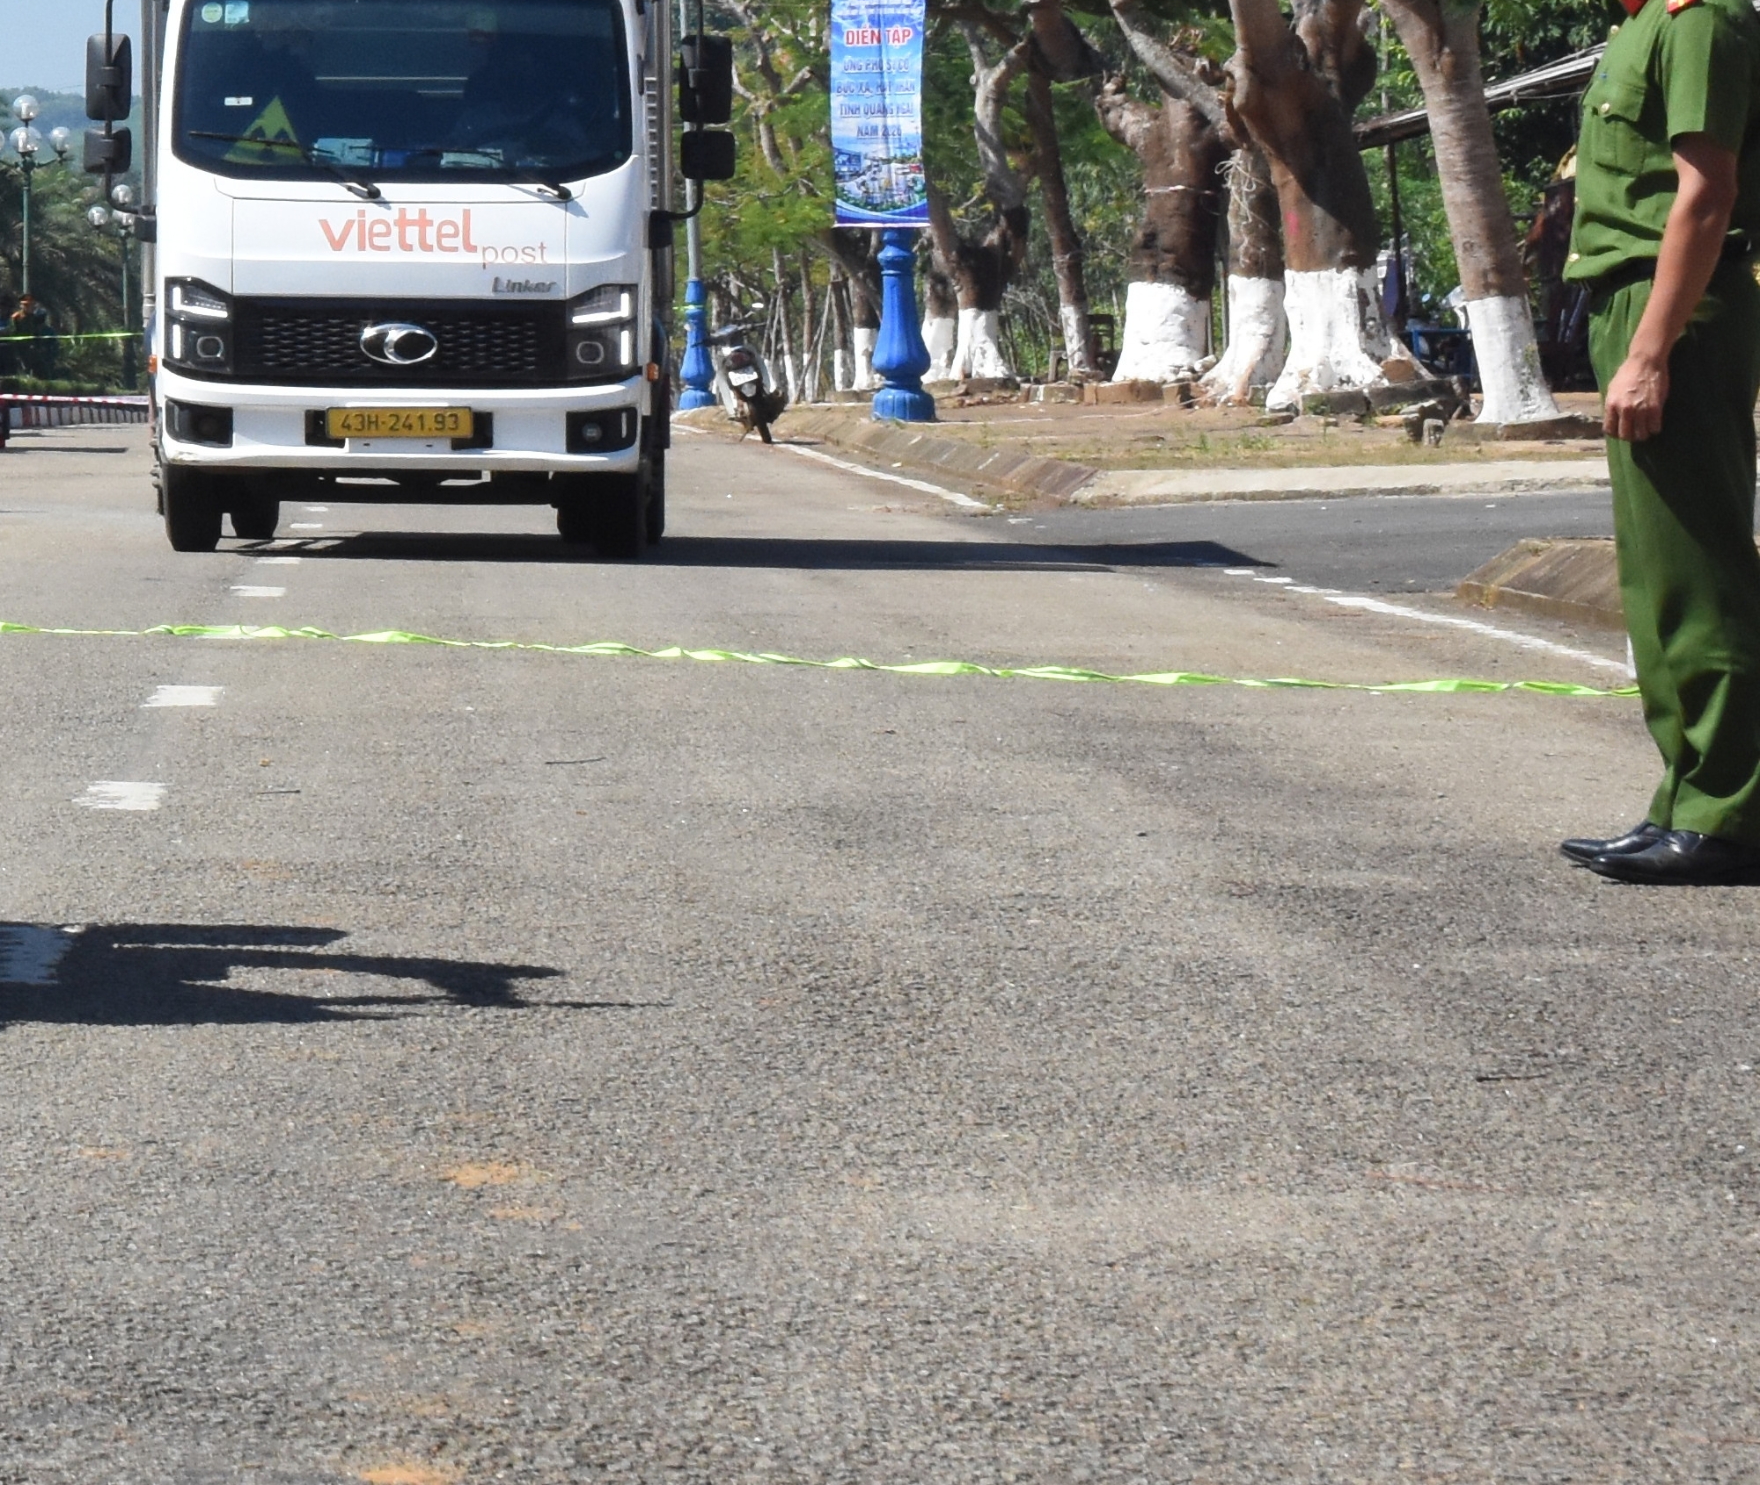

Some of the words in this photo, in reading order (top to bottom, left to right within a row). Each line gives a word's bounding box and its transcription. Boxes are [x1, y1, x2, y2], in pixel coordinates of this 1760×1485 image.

[318, 208, 478, 253] viettel
[482, 242, 548, 270] post
[341, 413, 459, 432] 43H-241.93
